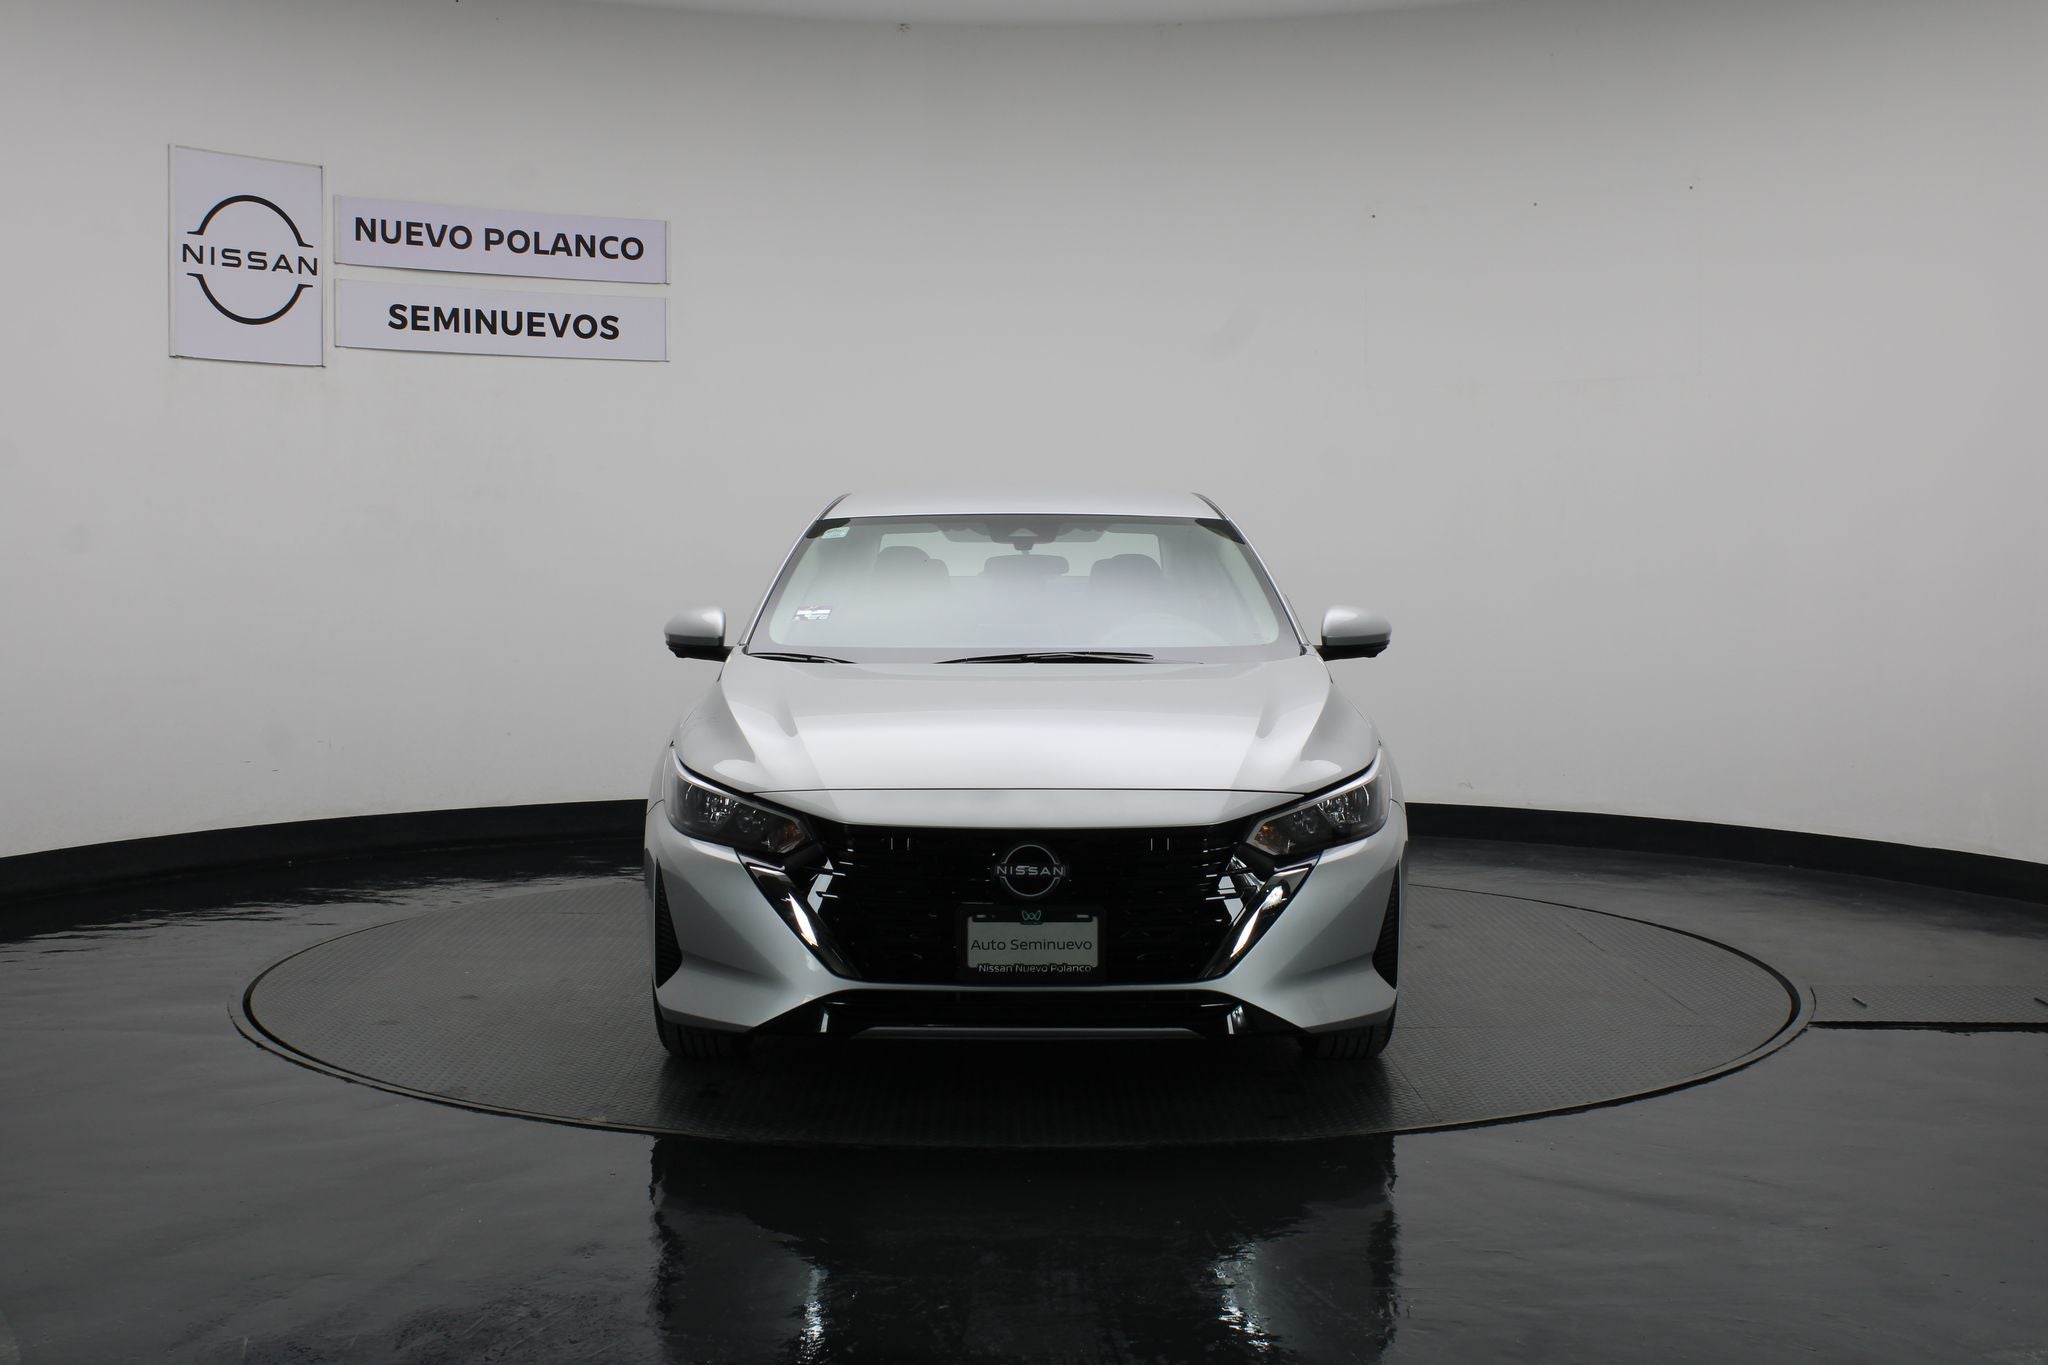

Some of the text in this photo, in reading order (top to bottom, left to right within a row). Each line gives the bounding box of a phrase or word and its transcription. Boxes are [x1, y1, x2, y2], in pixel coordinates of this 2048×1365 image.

[354, 216, 645, 261] NUEVO POLANCO
[182, 243, 318, 276] NISSAN
[387, 303, 621, 340] SEMINUEVOS
[996, 865, 1065, 876] NISSAN
[970, 939, 1093, 951] Auto Seminuevo
[978, 963, 1092, 973] Nissan Nuevo Polanco
